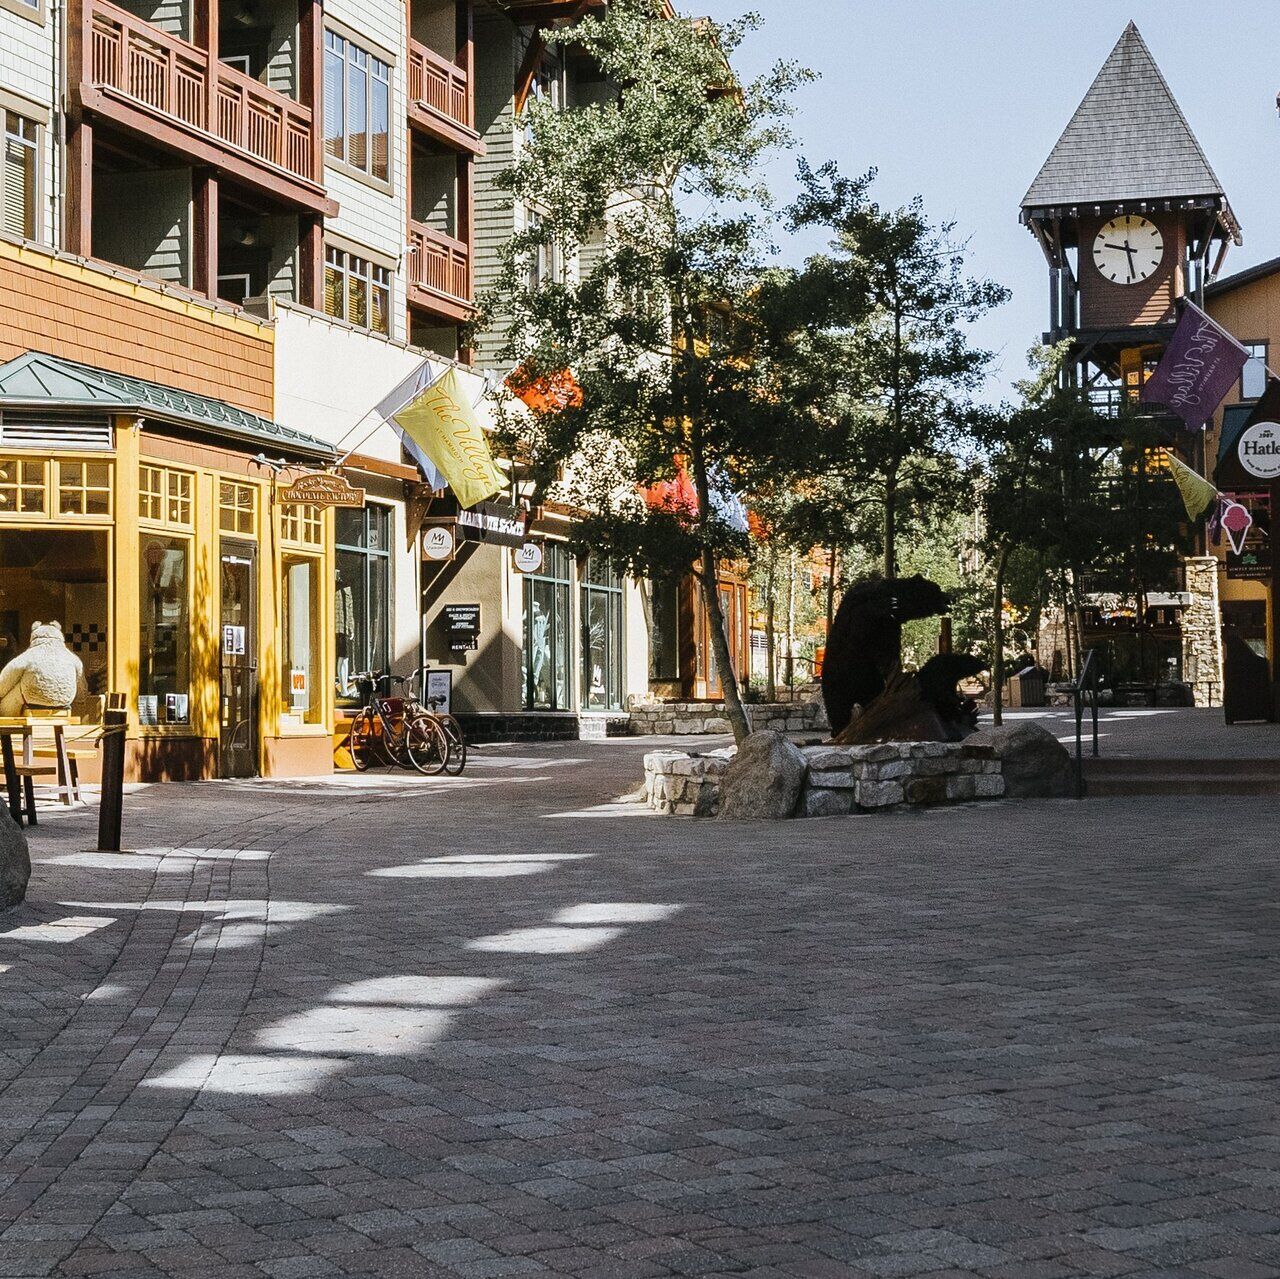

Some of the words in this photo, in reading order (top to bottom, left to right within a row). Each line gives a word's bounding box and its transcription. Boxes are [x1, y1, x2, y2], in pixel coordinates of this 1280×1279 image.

[426, 387, 461, 422] The
[451, 418, 493, 494] Village
[326, 491, 358, 501] FACTORY
